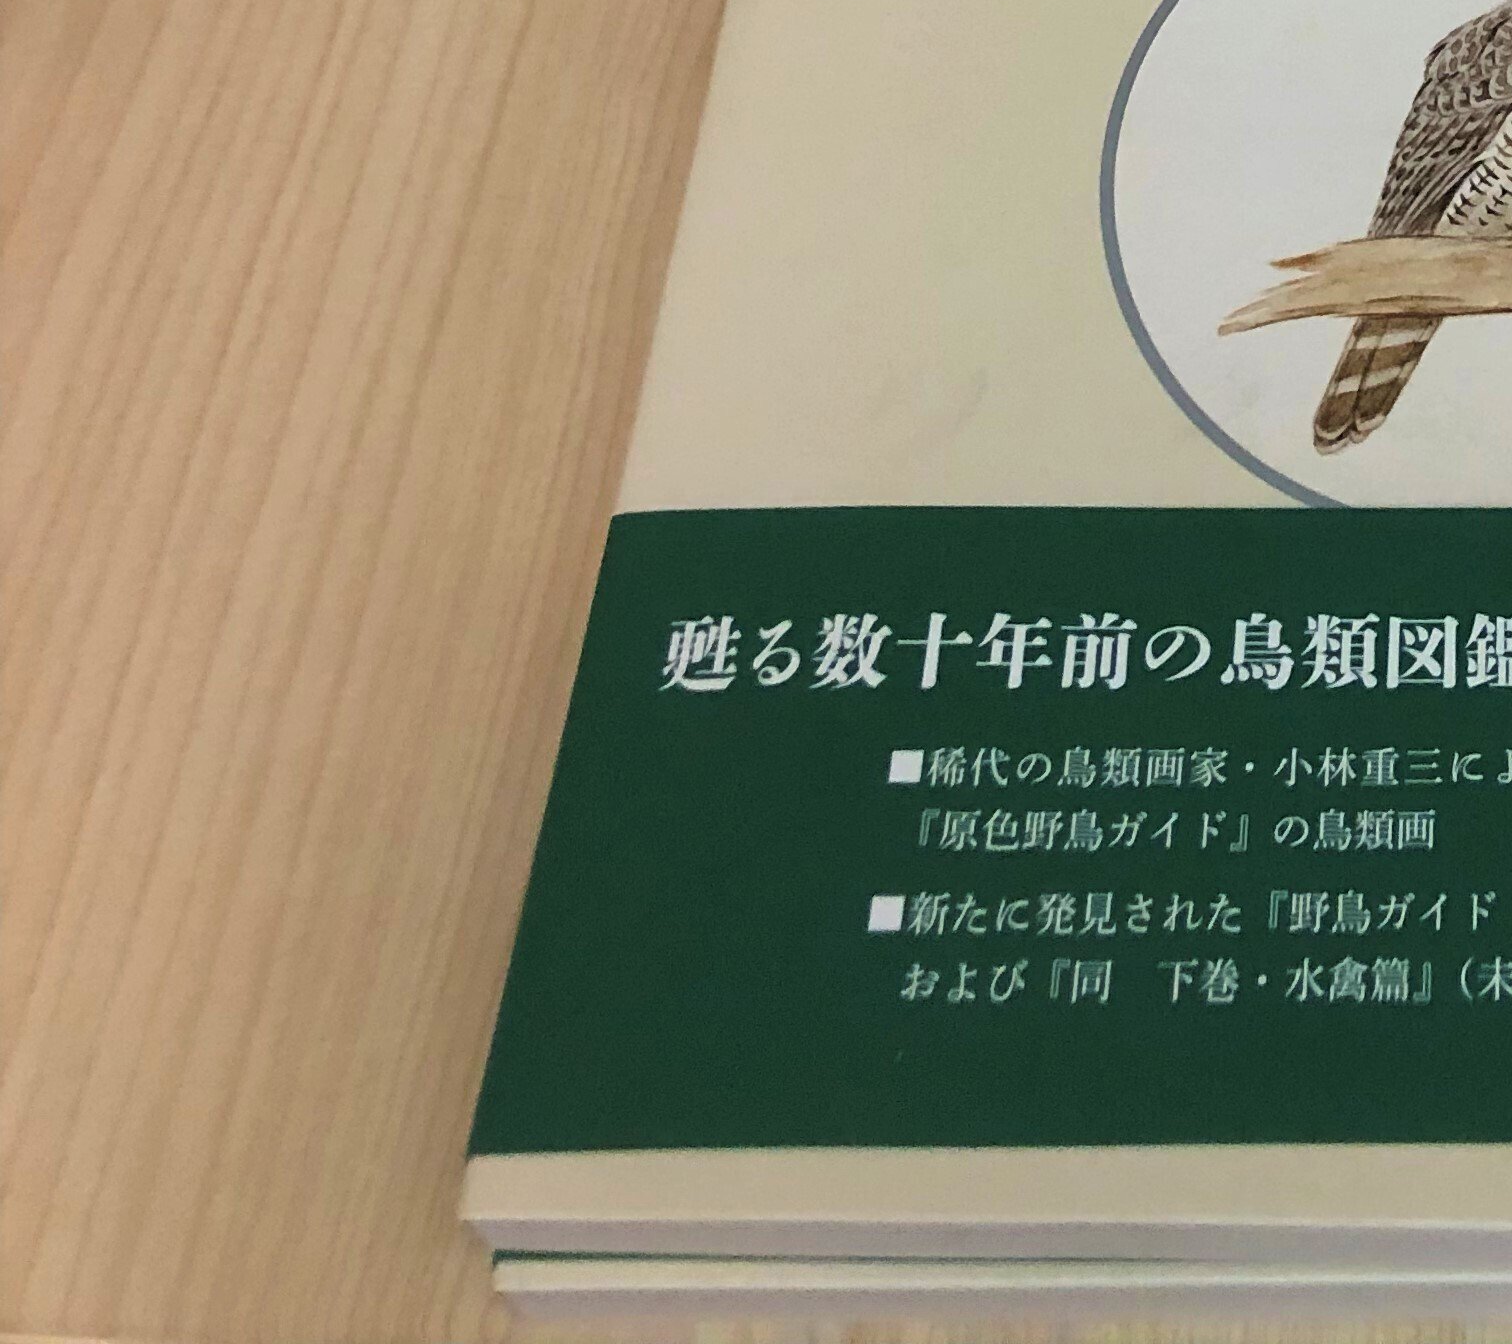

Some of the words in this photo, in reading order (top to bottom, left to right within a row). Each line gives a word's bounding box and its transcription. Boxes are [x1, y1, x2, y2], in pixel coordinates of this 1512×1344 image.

[918, 807, 1437, 853] 『原色野鳥ガイド』の鳥類画
